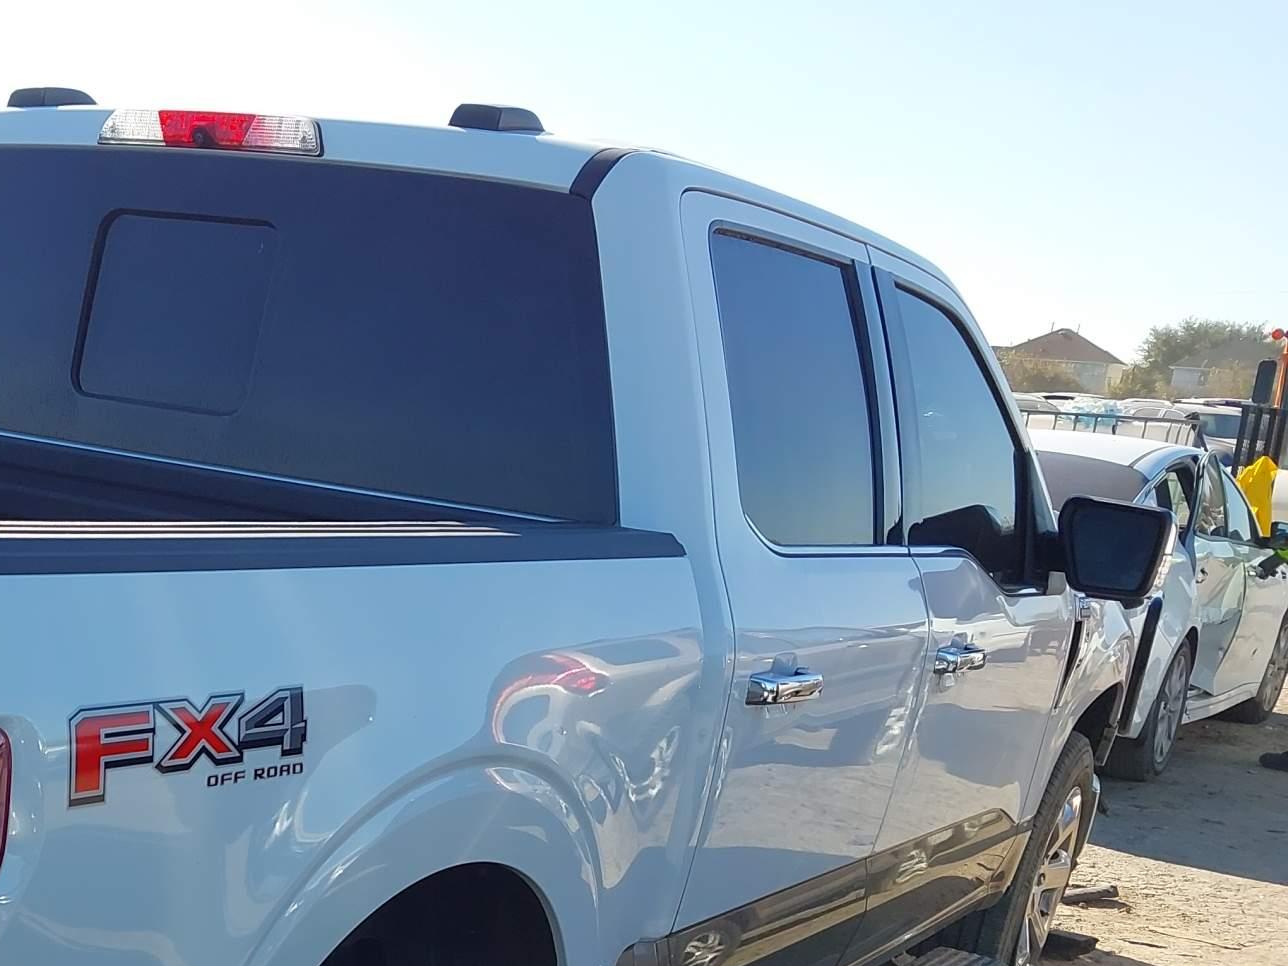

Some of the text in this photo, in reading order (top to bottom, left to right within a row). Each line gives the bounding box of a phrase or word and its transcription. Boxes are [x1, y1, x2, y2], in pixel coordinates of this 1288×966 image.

[69, 686, 307, 807] FX4
[207, 762, 304, 787] OFF ROAD
